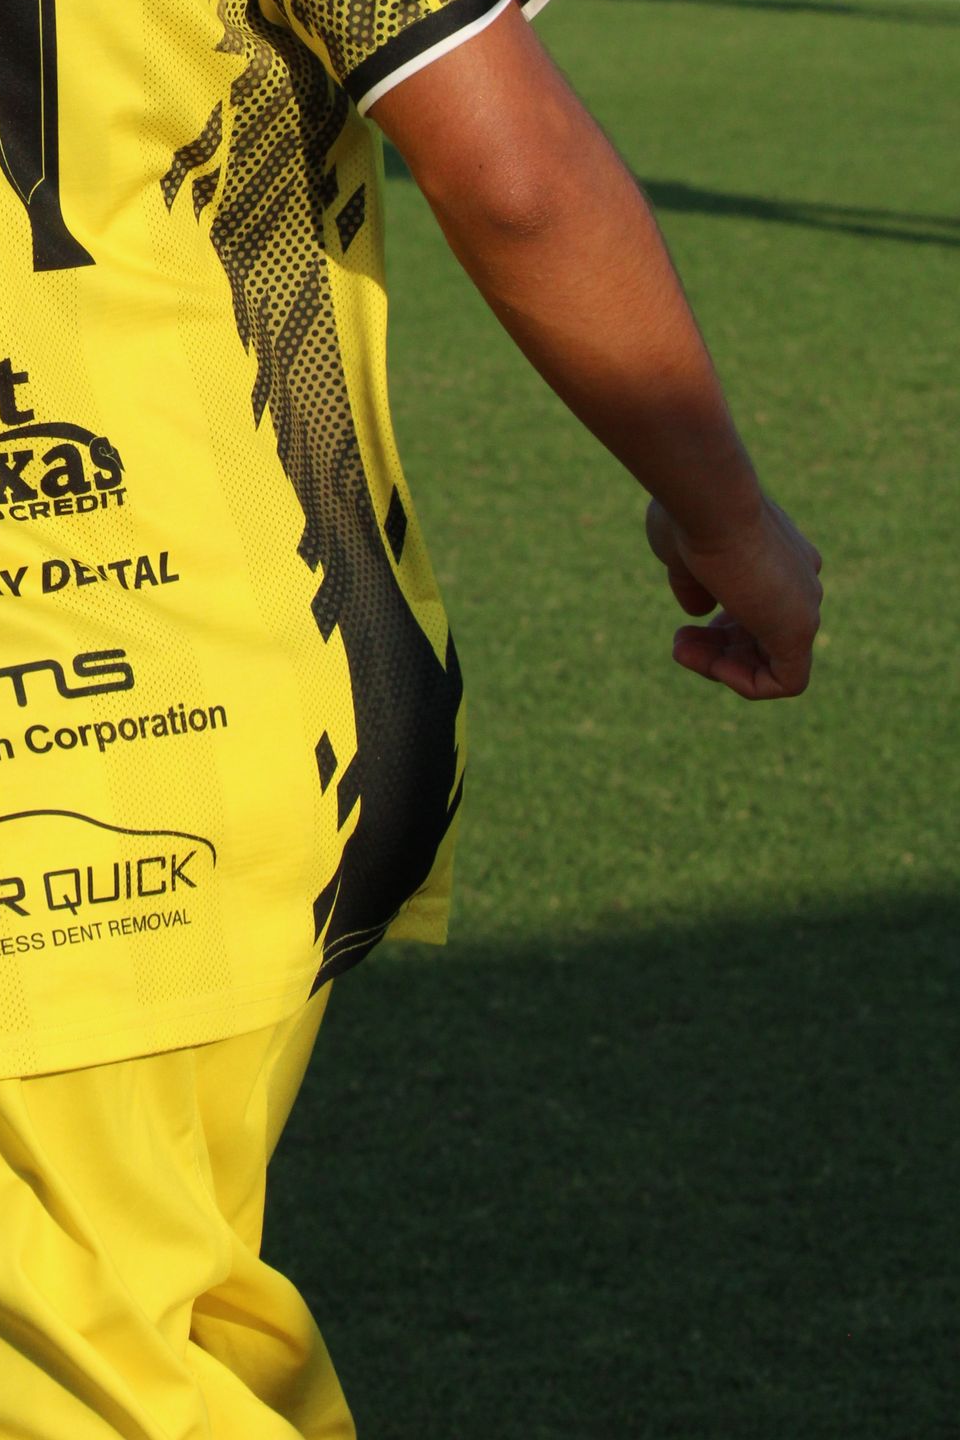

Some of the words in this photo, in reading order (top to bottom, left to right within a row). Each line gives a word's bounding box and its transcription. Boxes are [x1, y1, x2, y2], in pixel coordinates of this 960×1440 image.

[24, 703, 228, 754] Corporation
[43, 850, 198, 916] QUICK
[52, 922, 104, 947] DENT
[108, 908, 192, 936] REMOVAL
